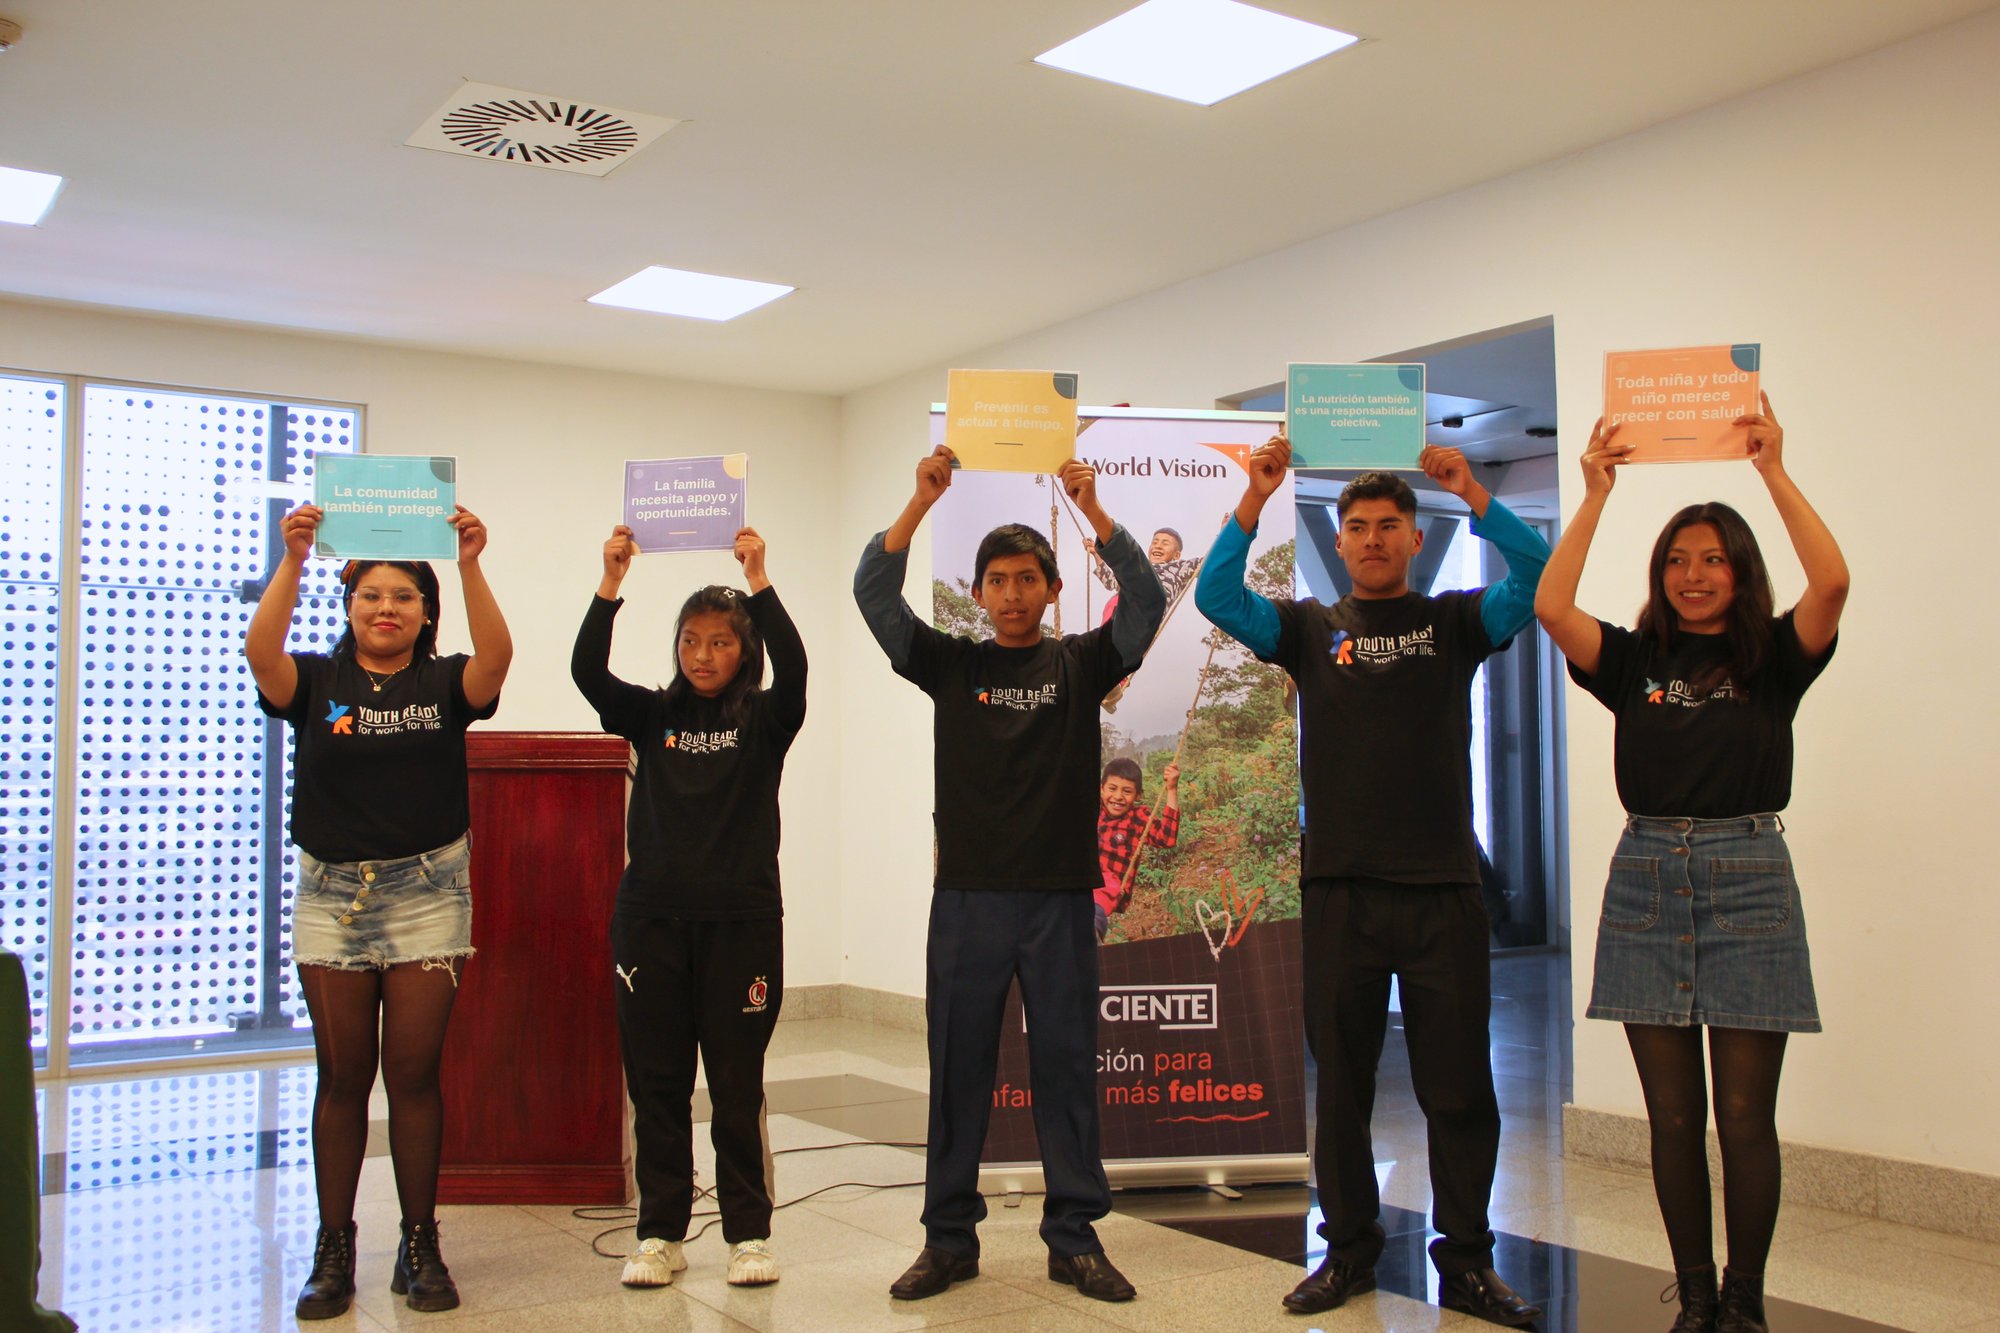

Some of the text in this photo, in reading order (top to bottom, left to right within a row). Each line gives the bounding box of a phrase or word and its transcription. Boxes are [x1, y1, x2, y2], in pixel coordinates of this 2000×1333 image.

[1615, 371, 1749, 389] Toda niña y todo
[1302, 394, 1410, 404] La nutrición también
[1632, 391, 1730, 405] niño merece
[974, 401, 1049, 414] Prevenir es
[1295, 406, 1417, 417] es una responsabilidad
[1330, 418, 1381, 427] colectiva.
[1612, 410, 1662, 423] crecer
[1666, 410, 1696, 420] con
[957, 417, 1064, 432] actuar a tiempo.
[1083, 456, 1226, 478] World Vision
[655, 478, 715, 491] La familia
[334, 485, 437, 499] La comunidad
[631, 493, 738, 506] necesita apoyo y
[324, 501, 447, 517] también protege.
[636, 506, 731, 522] oportunidades.
[1356, 636, 1395, 652] YOUTH
[1403, 646, 1417, 656] for
[992, 684, 1056, 700] YOUTH REDY
[991, 697, 1004, 705] for
[359, 704, 438, 724] YOUTH READY
[358, 724, 372, 735] for
[407, 721, 421, 730] for
[1100, 994, 1208, 1022] CIENTE
[1155, 1051, 1212, 1077] para
[1106, 1079, 1264, 1105] más felices
